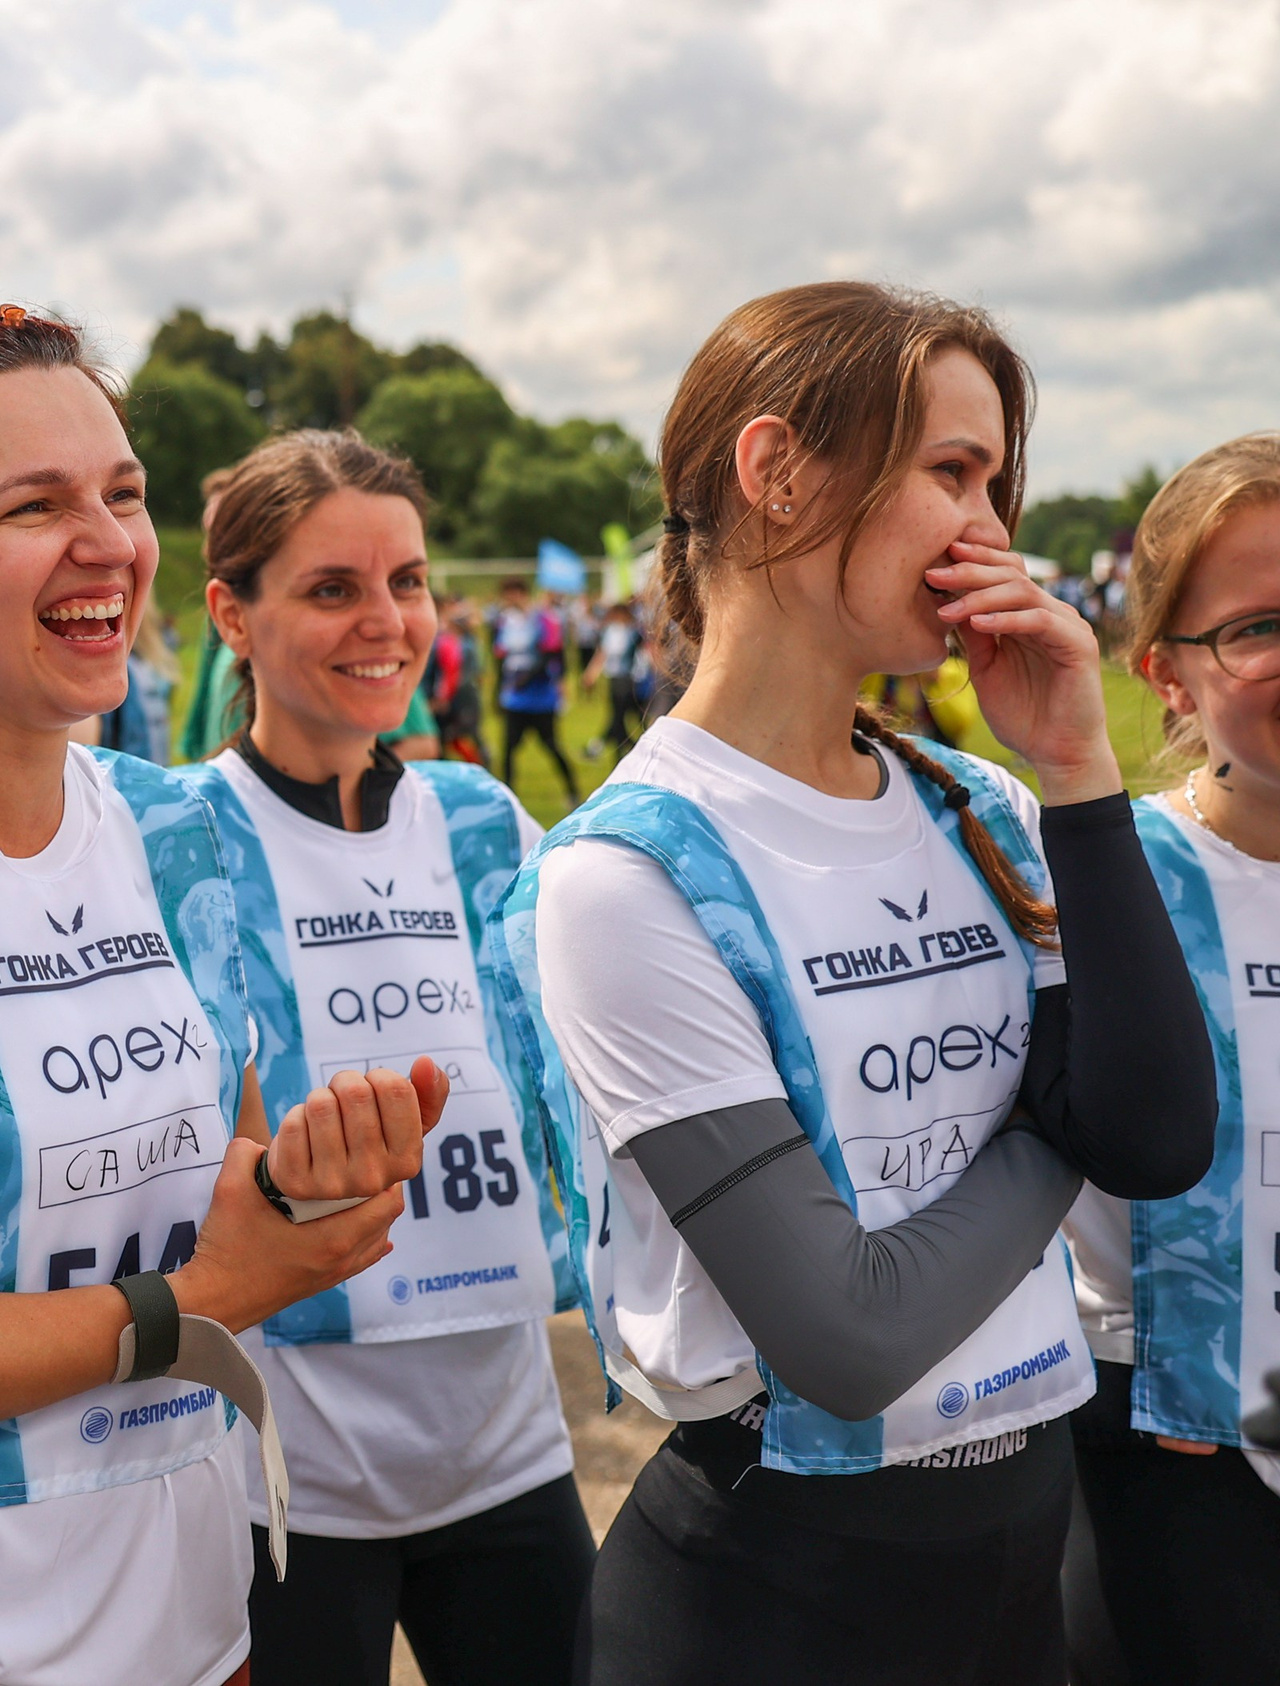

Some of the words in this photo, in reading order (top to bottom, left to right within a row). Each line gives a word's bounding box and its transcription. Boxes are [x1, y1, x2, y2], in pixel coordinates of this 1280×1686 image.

[295, 911, 384, 939] ГОНКА
[389, 909, 457, 931] ГЕРОЕВ
[77, 932, 170, 971] ГЕРОЕВ
[802, 942, 913, 985] ГОНКА
[42, 1016, 201, 1100] apex
[859, 1014, 1018, 1101] apex
[66, 1118, 200, 1191] САША
[880, 1123, 973, 1187] ИРА
[417, 1264, 518, 1294] ГАЗПРОМБАНК
[974, 1338, 1071, 1401] ГАЗПРОМБАНК
[119, 1387, 217, 1430] ГАЗПРОМБАН
